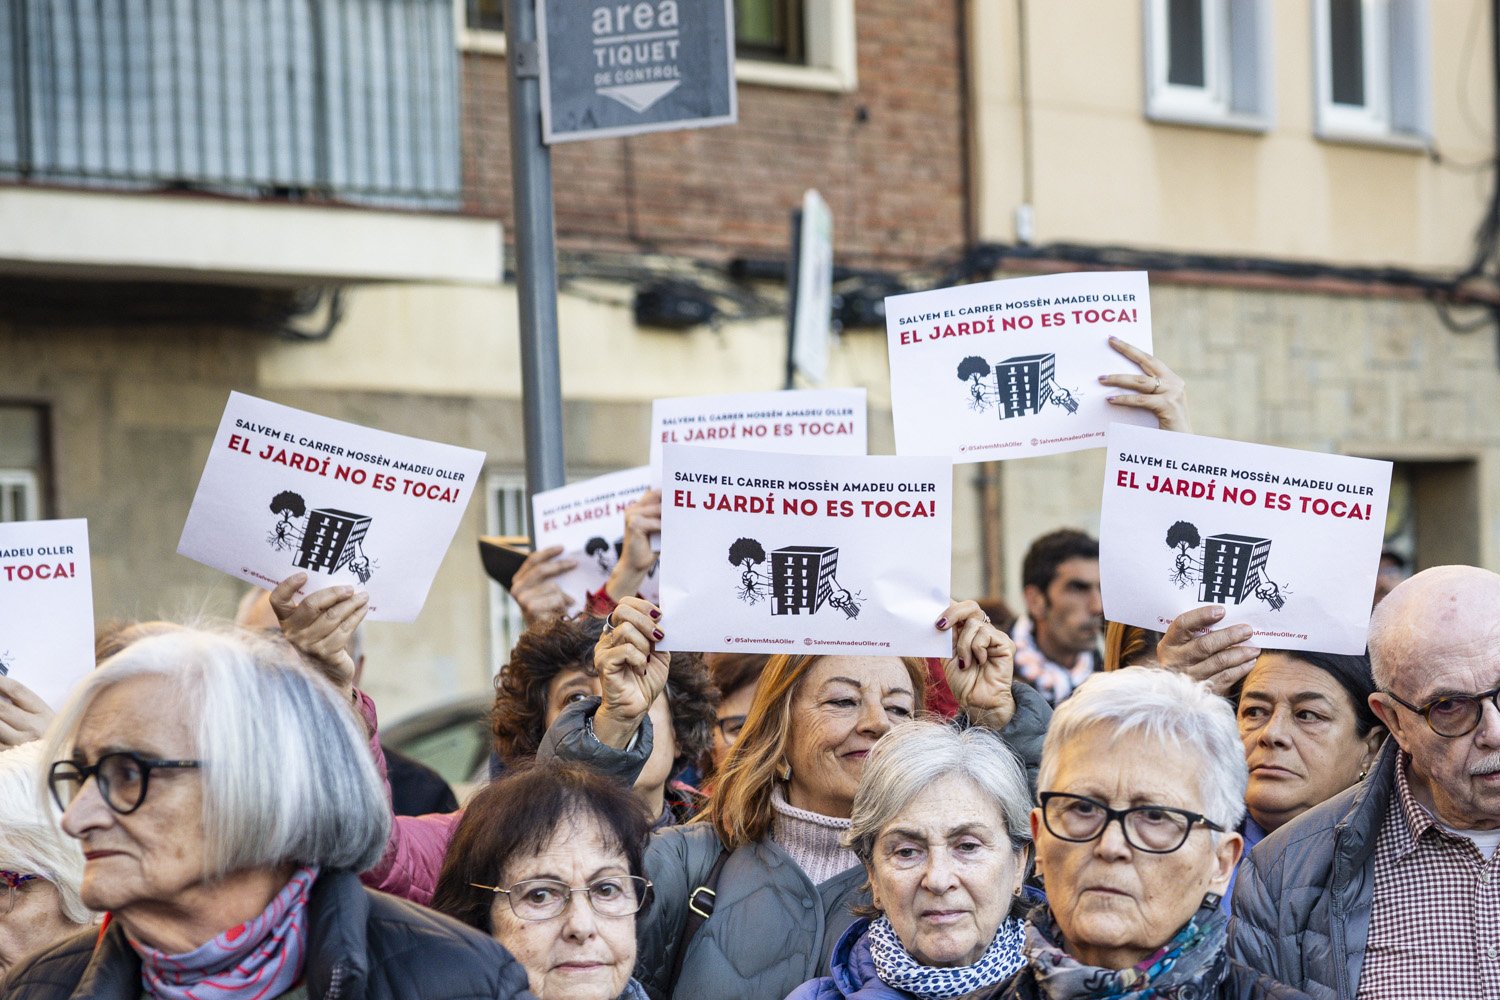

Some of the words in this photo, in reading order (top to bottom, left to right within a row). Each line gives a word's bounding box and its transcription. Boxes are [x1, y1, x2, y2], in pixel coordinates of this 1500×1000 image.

[593, 40, 680, 67] TIQUET
[594, 73, 611, 85] DE
[615, 65, 681, 83] CONTROL
[899, 312, 940, 325] SALVEM
[959, 304, 1002, 315] CARRER
[1006, 299, 1050, 310] MOSSÈN
[1054, 295, 1099, 304] AMADEU
[899, 329, 923, 345] EL
[928, 315, 996, 340] JARDÍ
[1001, 314, 1034, 331] NO
[1040, 312, 1067, 327] ES
[1071, 308, 1137, 324] TOCA!
[661, 431, 677, 444] EL
[685, 424, 736, 442] JARDÍ
[741, 425, 768, 437] NO
[772, 423, 793, 437] ES
[799, 419, 854, 435] TOCA!
[236, 419, 281, 439] SALVEM
[284, 433, 295, 443] EL
[299, 438, 344, 456] CARRER
[347, 450, 390, 466] MOSSÈN
[392, 461, 433, 475] AMADEU
[436, 469, 464, 481] OLLER
[228, 434, 252, 455] EL
[258, 445, 330, 476] JARDÍ
[333, 464, 367, 485] NO
[371, 473, 397, 492] ES
[402, 479, 459, 502] TOCA!
[675, 472, 717, 484] SALVEM
[722, 476, 733, 485] EL
[737, 478, 784, 489] CARRER
[789, 480, 838, 491] MOSSÈN
[843, 483, 893, 492] AMADEU
[898, 483, 935, 492] OLLER
[1120, 453, 1162, 467] SALVEM
[1166, 460, 1177, 469] EL
[1181, 462, 1227, 476] CARRER
[1231, 469, 1279, 484] MOSSÈN
[1283, 477, 1333, 490] AMADEU
[1337, 484, 1373, 495] OLLER
[673, 489, 696, 508] EL
[703, 493, 775, 514] JARDÍ
[782, 498, 819, 516] NO
[826, 499, 855, 517] ES
[861, 499, 936, 518] TOCA!
[1116, 469, 1139, 489] EL
[1145, 475, 1216, 500] JARDÍ
[1221, 486, 1257, 506] NO
[1264, 491, 1291, 510] ES
[1299, 495, 1372, 520] TOCA!
[37, 545, 74, 556] OLLER
[4, 562, 75, 581] TOCA!
[814, 639, 891, 647] SalvemAmadeuOller.org
